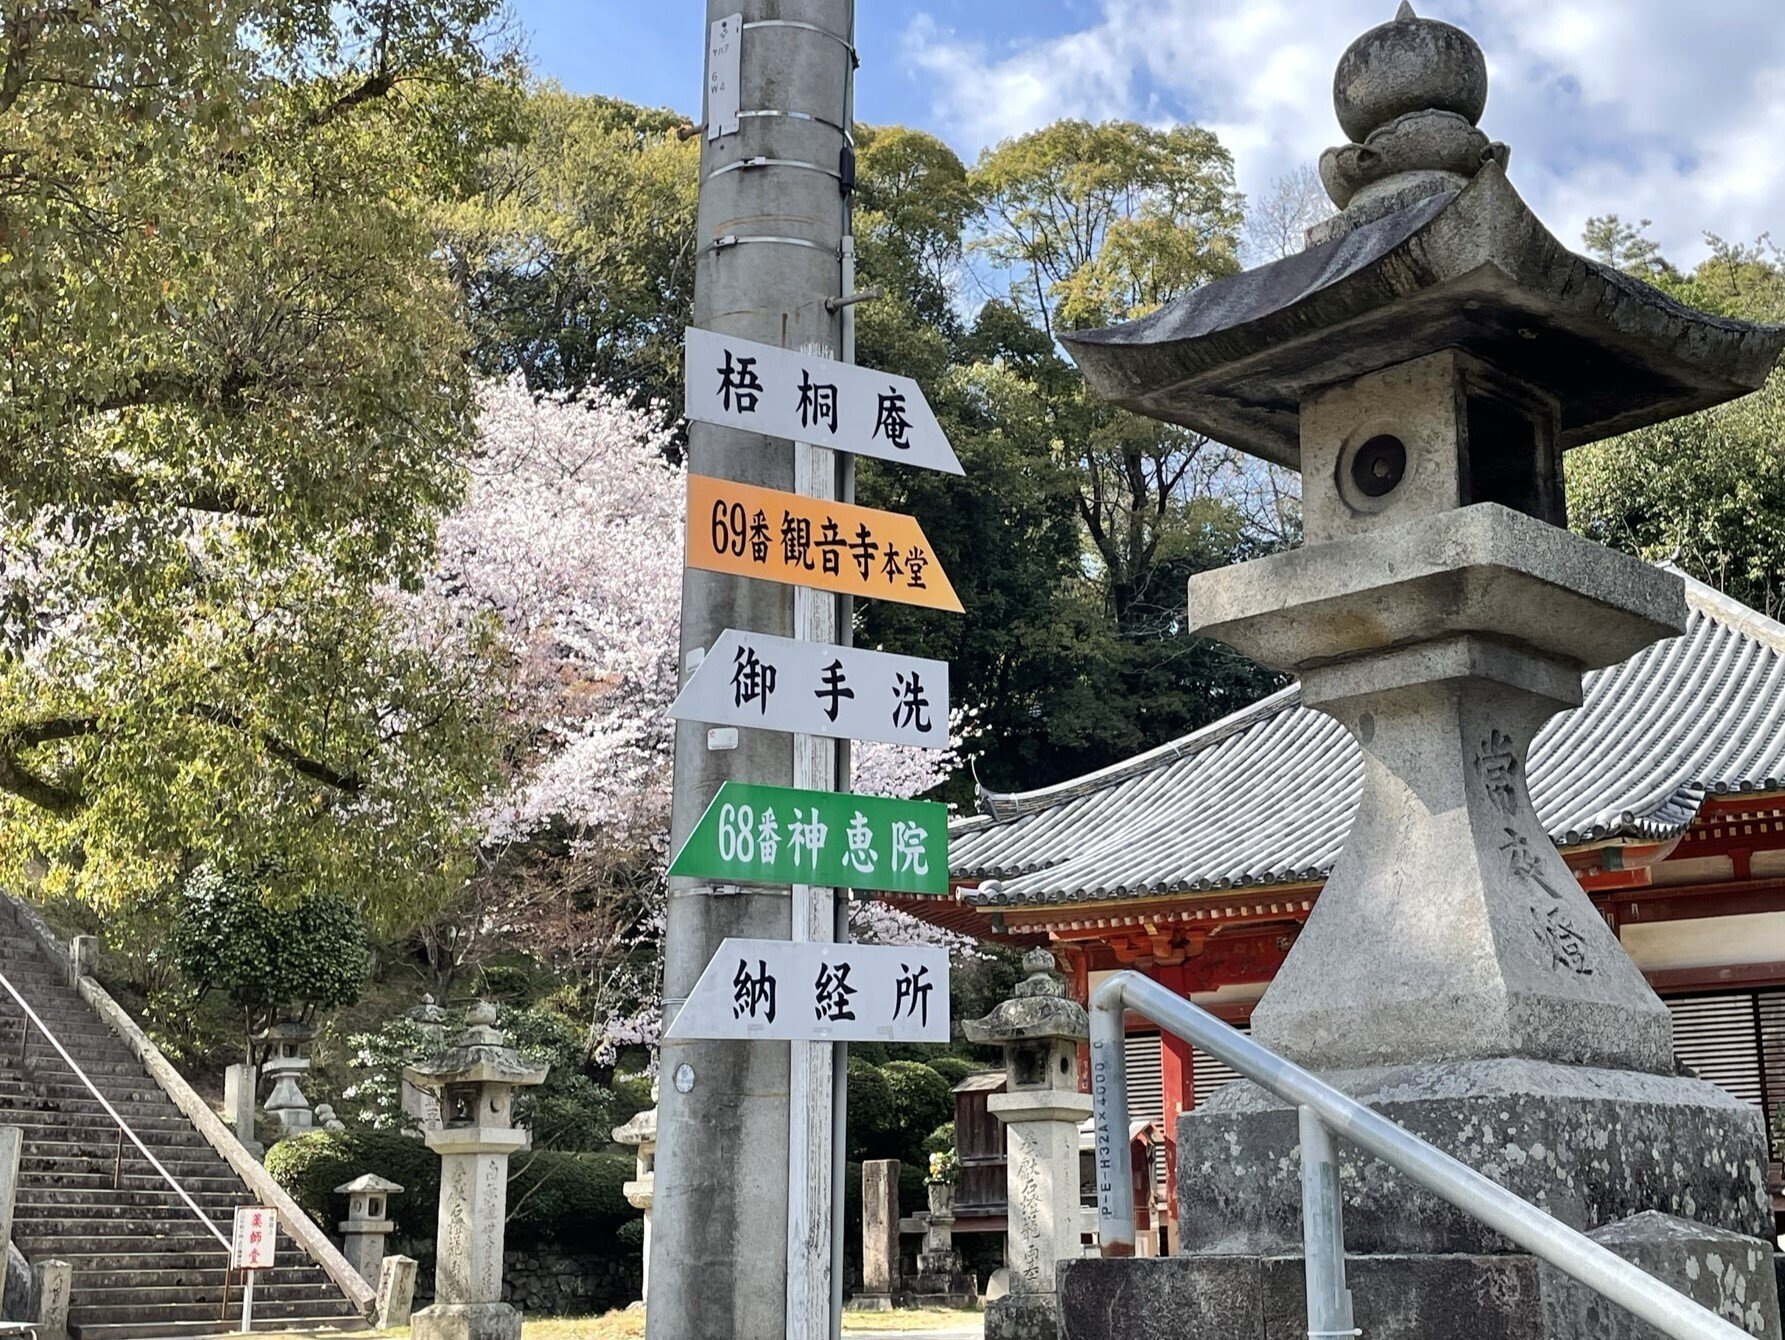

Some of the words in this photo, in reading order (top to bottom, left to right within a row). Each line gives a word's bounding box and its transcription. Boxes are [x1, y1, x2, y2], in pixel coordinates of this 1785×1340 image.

[715, 348, 914, 450] 梧桐庵
[711, 499, 929, 590] 69番観音寺本堂
[730, 645, 932, 733] 御手洗
[717, 803, 930, 876] 68番神恵院
[732, 958, 933, 1028] 納経所
